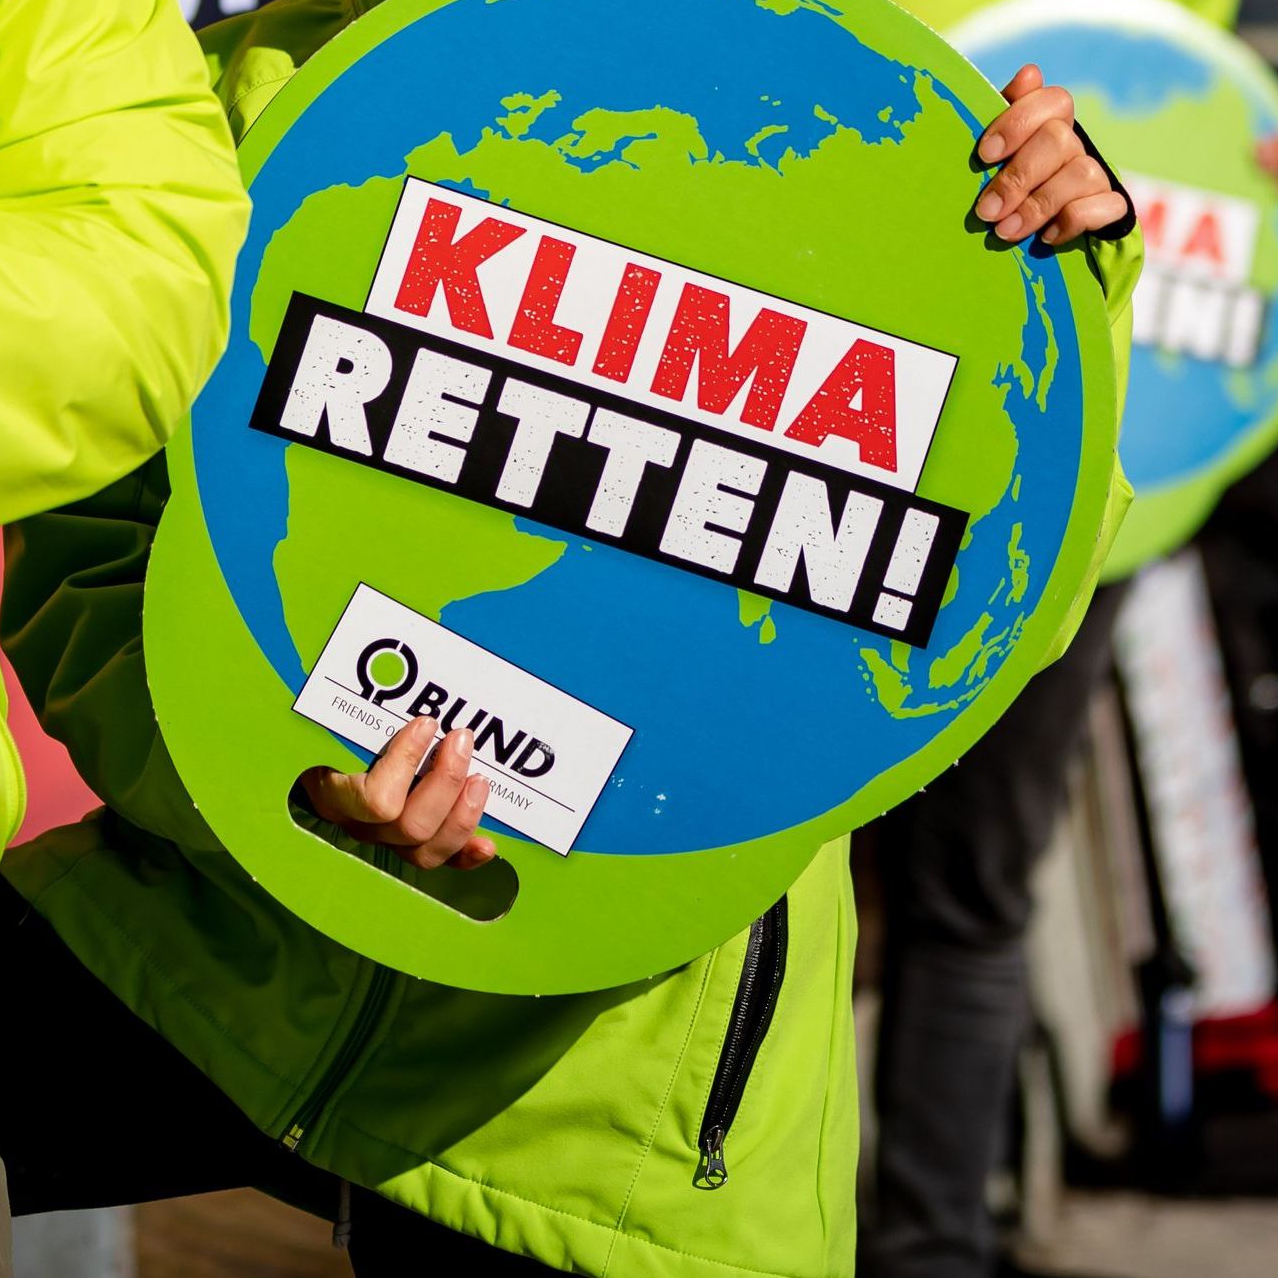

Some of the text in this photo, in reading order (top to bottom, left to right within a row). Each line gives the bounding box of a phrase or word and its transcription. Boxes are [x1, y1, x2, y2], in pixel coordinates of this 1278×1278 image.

[393, 196, 897, 472] KLIMA
[278, 313, 940, 631] RETTEN!
[331, 695, 534, 811] FRIENDS O RMANY
[406, 681, 556, 779] BUND
